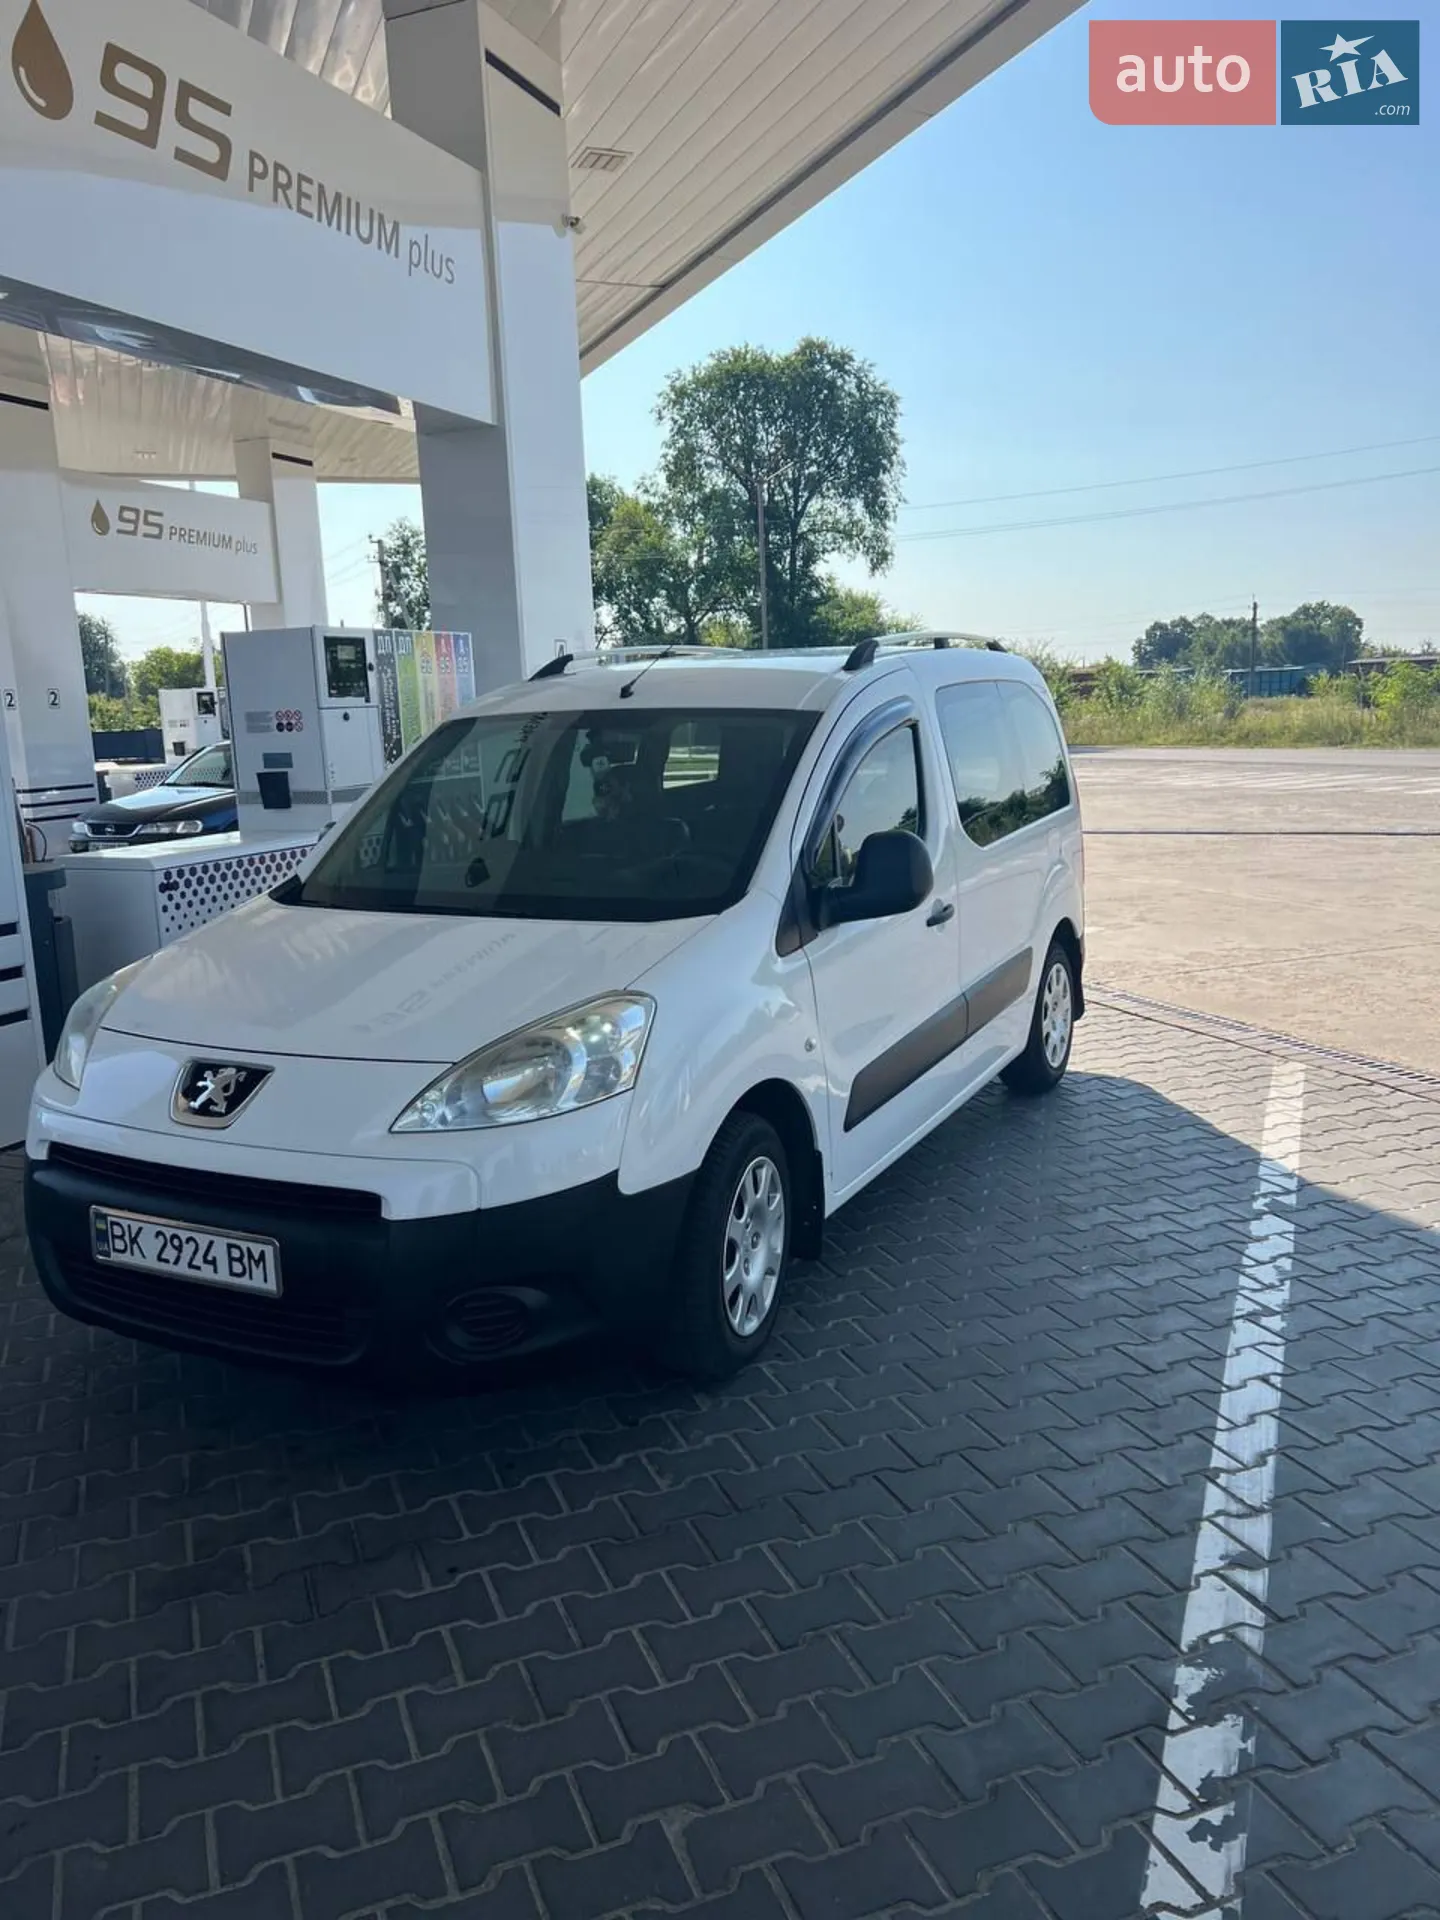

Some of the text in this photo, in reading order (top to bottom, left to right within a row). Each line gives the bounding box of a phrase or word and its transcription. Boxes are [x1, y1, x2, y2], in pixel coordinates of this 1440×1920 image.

[94, 42, 456, 285] 95 PREMIUM plus
[116, 505, 258, 555] 95 PREMIUM plus
[6, 692, 15, 707] 2
[49, 691, 58, 706] 2
[109, 1220, 268, 1284] BK 2924 BM
